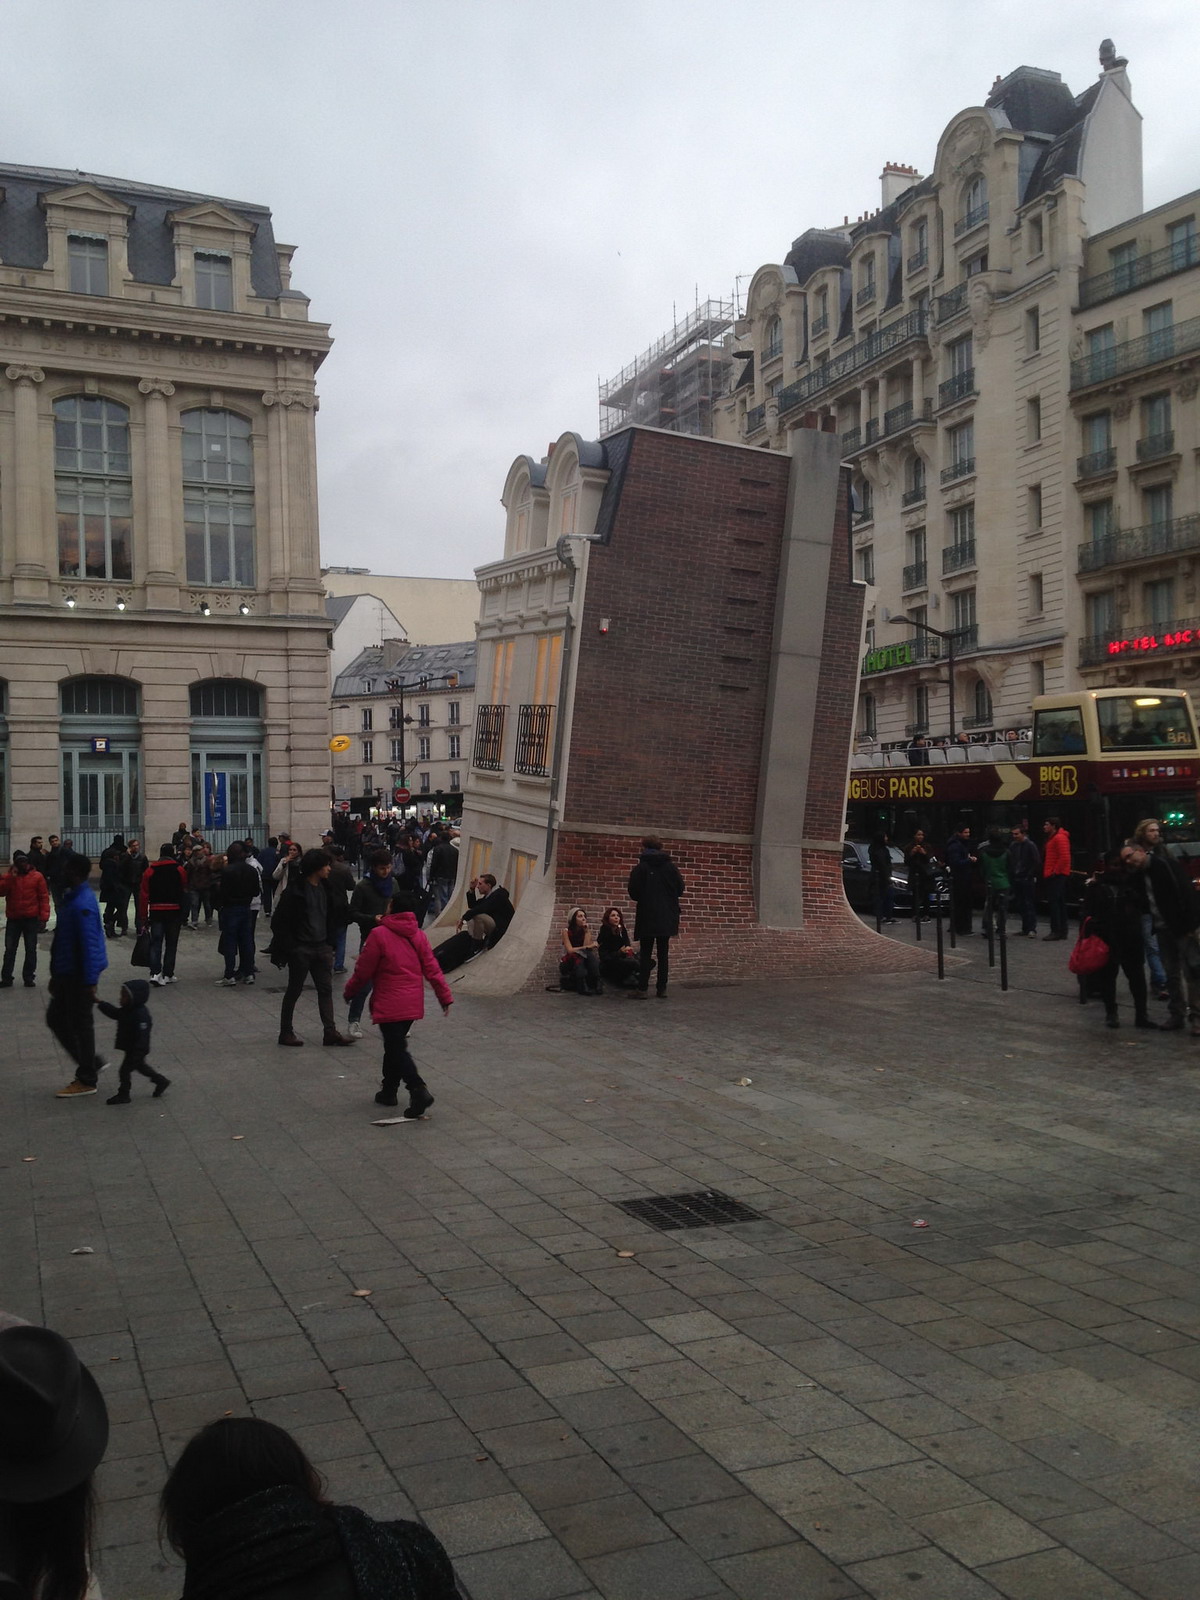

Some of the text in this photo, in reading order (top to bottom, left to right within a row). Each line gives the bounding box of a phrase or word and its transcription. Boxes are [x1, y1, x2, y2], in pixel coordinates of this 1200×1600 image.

[179, 351, 228, 370] NORD
[1108, 635, 1159, 654] HOTEL
[867, 644, 912, 672] HOTEL
[1040, 766, 1060, 781] BIG
[889, 776, 934, 798] PARIS
[1040, 782, 1060, 796] BUS
